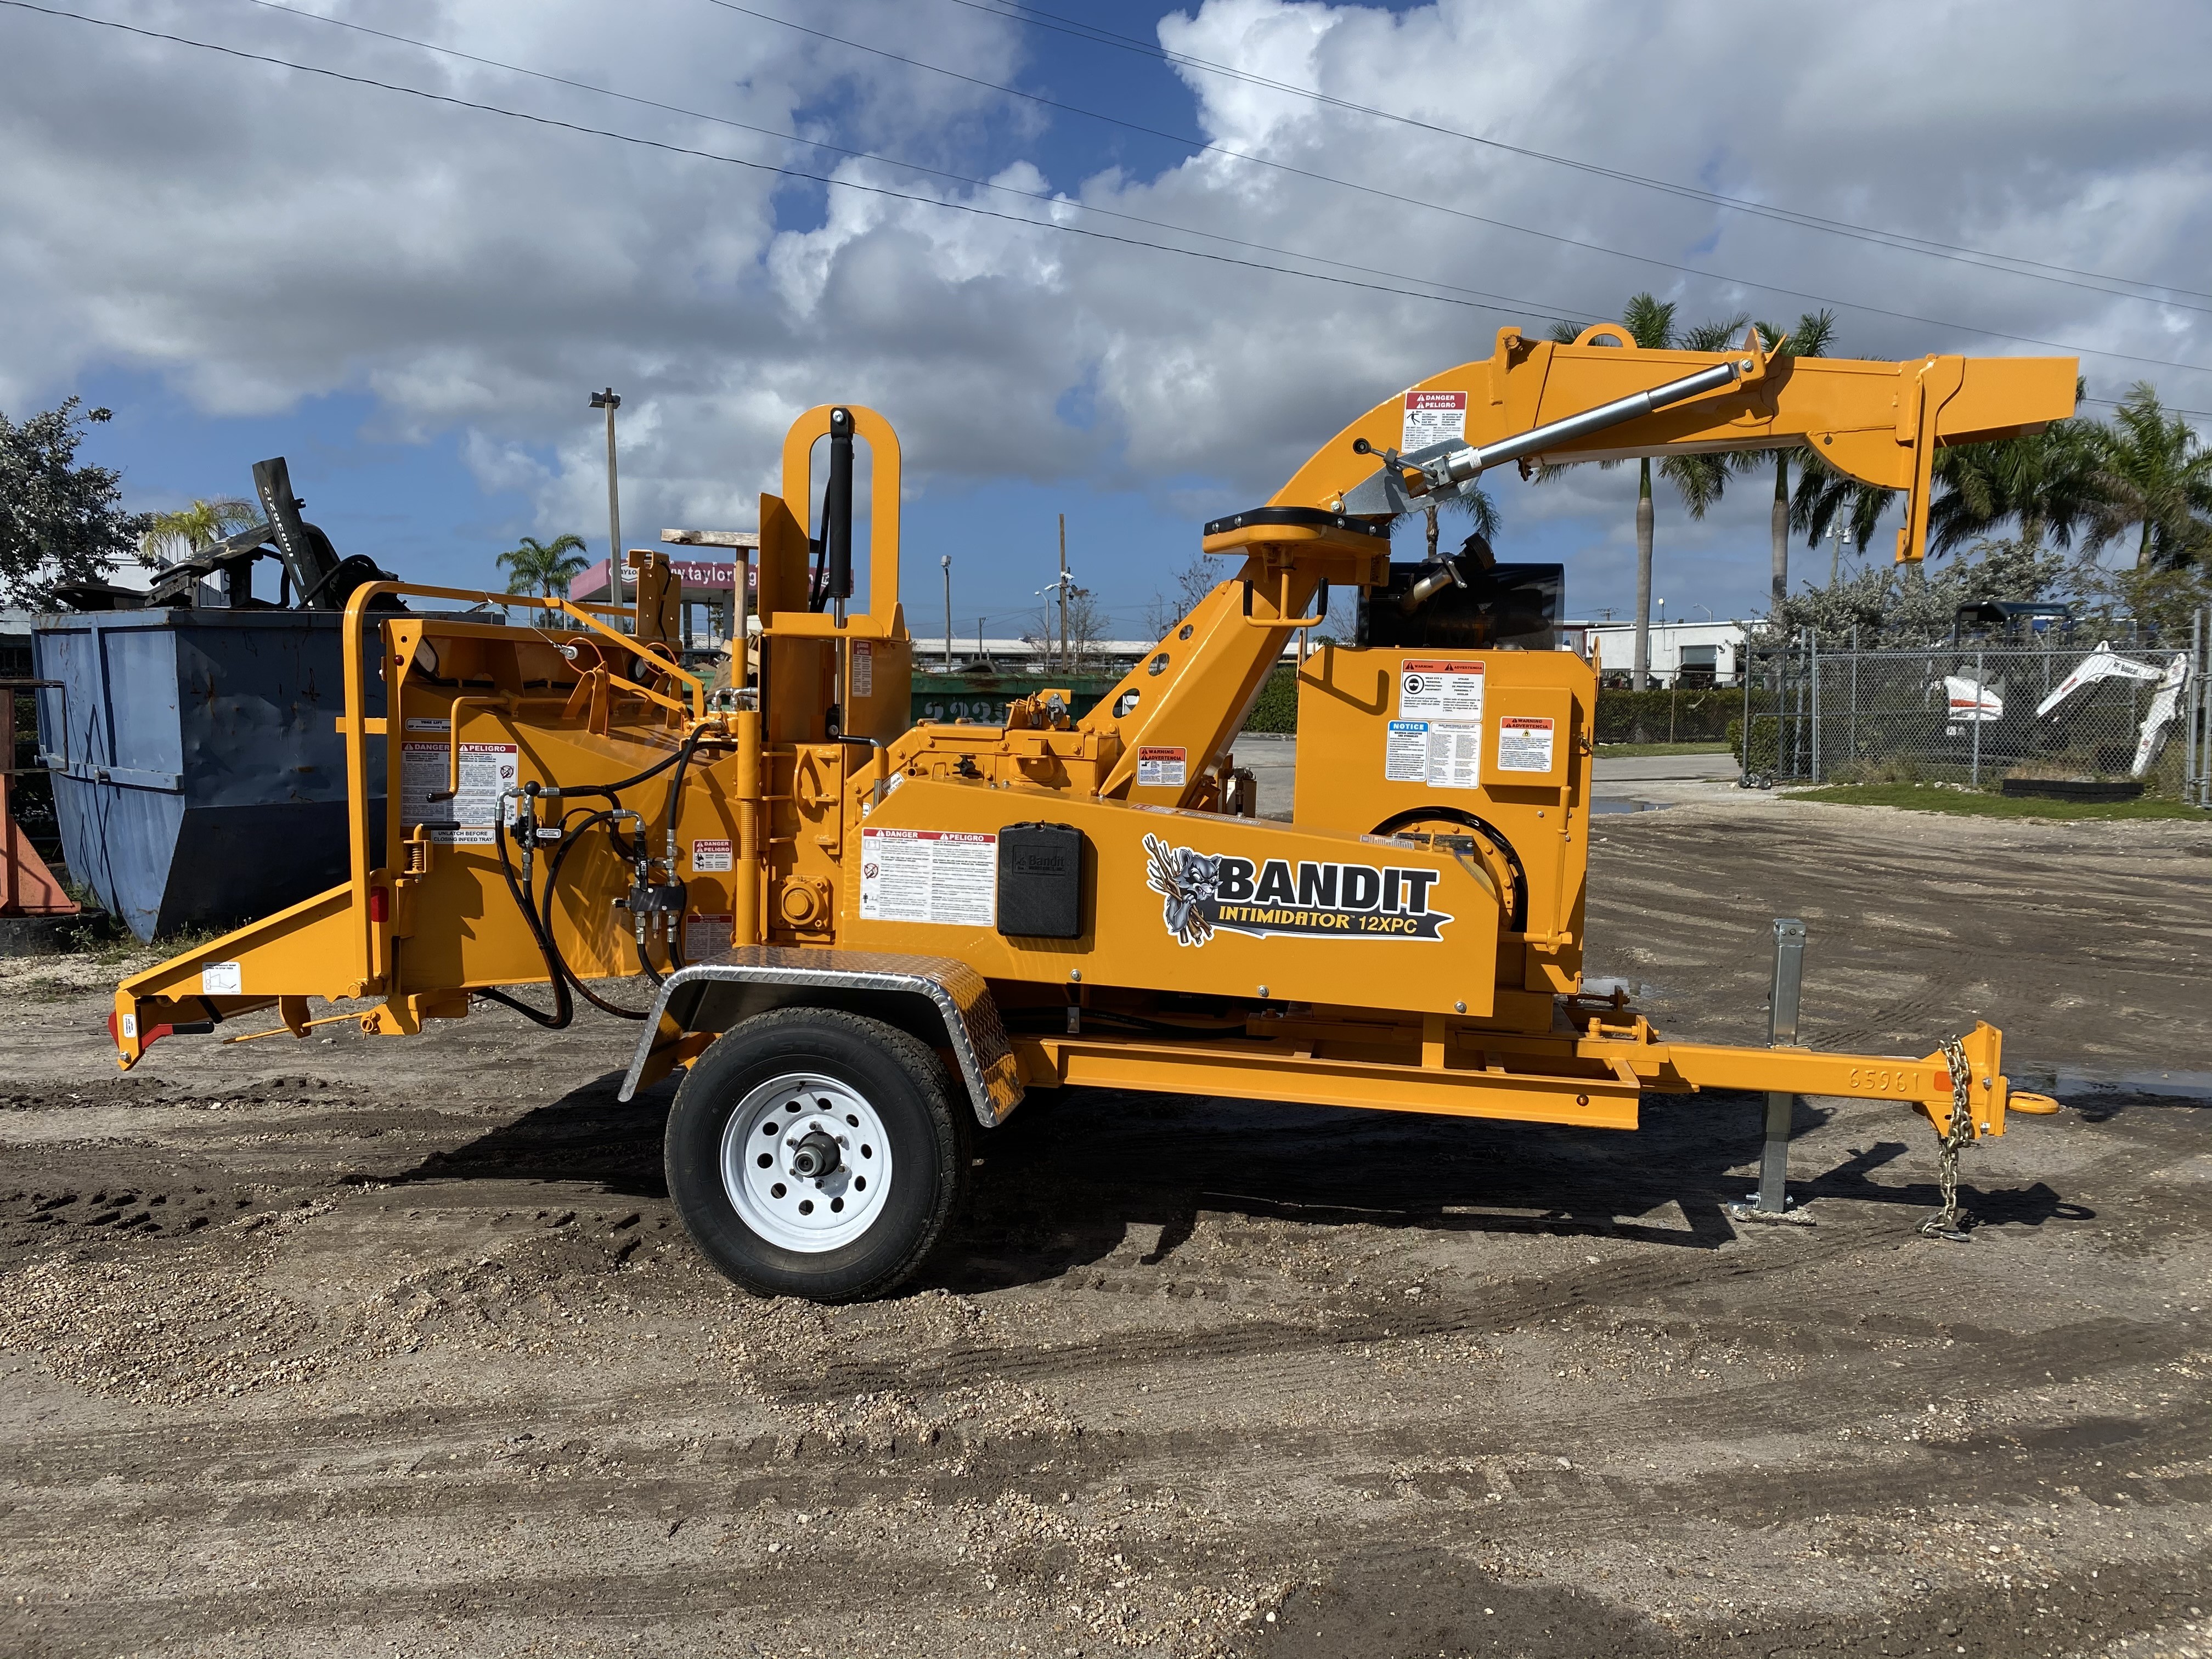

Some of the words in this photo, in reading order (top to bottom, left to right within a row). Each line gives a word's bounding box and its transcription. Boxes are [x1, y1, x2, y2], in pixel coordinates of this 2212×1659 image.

[1029, 854, 1065, 866] Bandit
[1218, 858, 1437, 913] BANDIT
[1359, 917, 1418, 934] 12XPC
[1849, 1068, 1919, 1093] 65961
